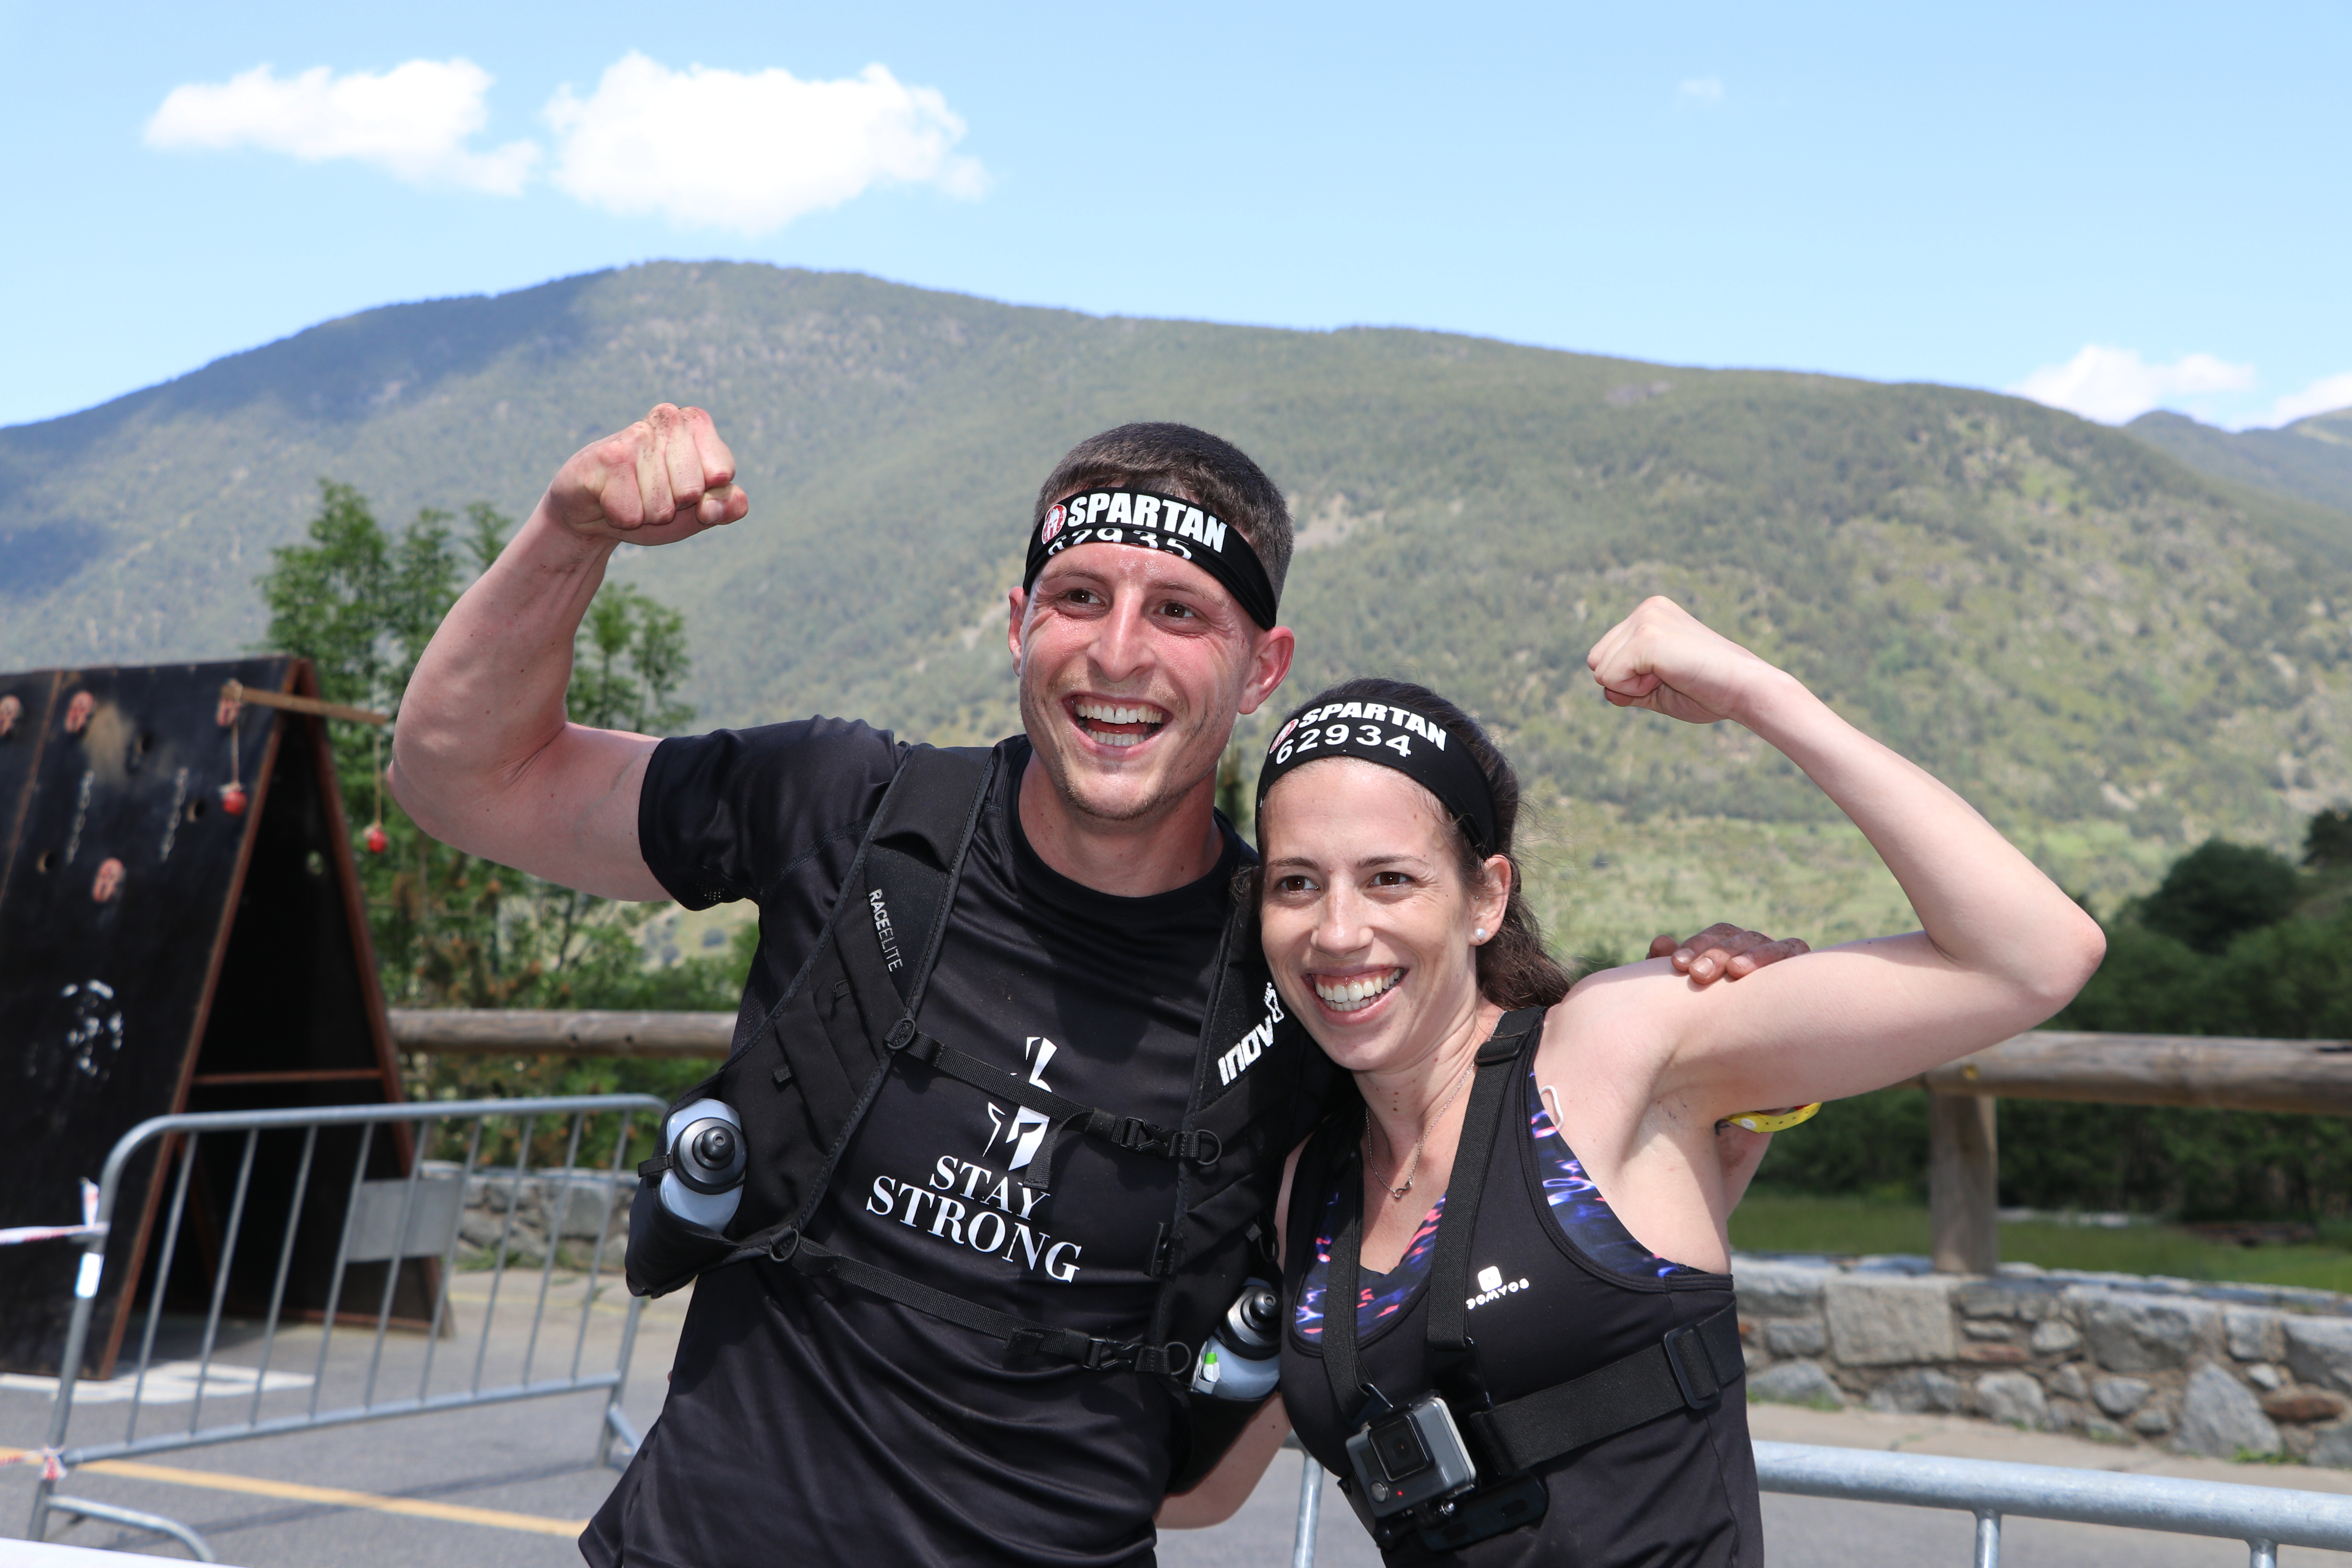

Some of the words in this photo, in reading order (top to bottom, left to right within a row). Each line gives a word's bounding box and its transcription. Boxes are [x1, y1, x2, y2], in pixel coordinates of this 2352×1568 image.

[1067, 492, 1228, 553] SPARTAN
[1276, 724, 1411, 764] 62934
[1298, 702, 1447, 751] SPARTAN
[929, 1155, 1051, 1220] STAY
[866, 1176, 1082, 1283] STRONG
[1466, 1278, 1530, 1310] DOMYOS
